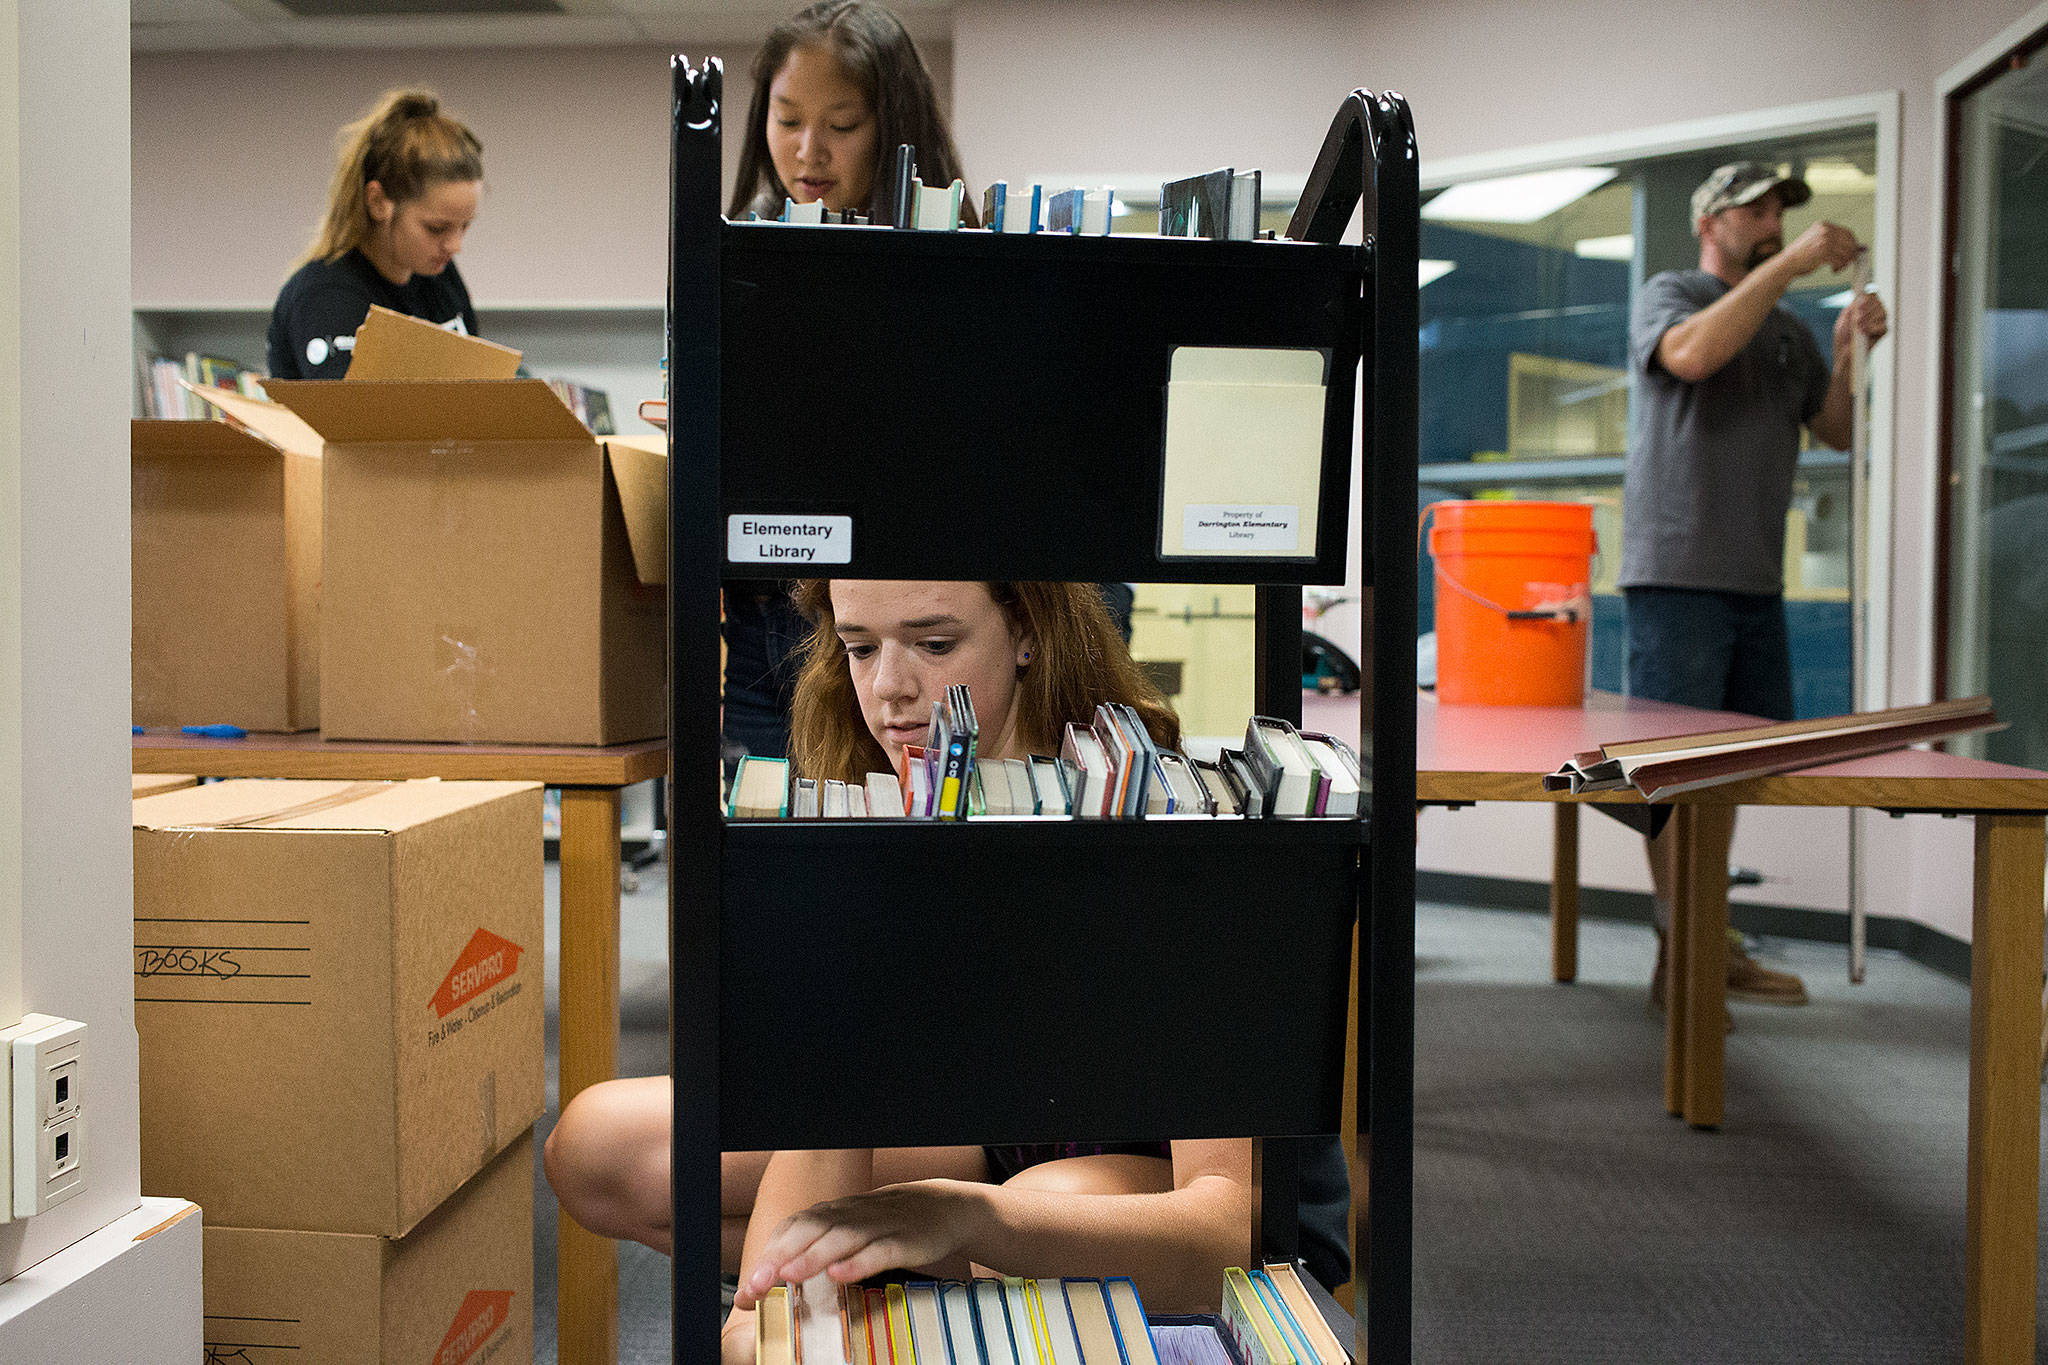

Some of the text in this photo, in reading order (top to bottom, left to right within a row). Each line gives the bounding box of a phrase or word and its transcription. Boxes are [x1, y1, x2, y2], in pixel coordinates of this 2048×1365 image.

[1223, 511, 1253, 519] Property
[743, 522, 833, 539] Elementary
[1198, 521, 1288, 529] Darrington Elementary
[1229, 531, 1255, 540] Library
[759, 544, 815, 560] Library
[138, 948, 241, 980] BOOKS
[452, 952, 503, 1000] SERVPRO
[428, 1031, 440, 1048] Fire
